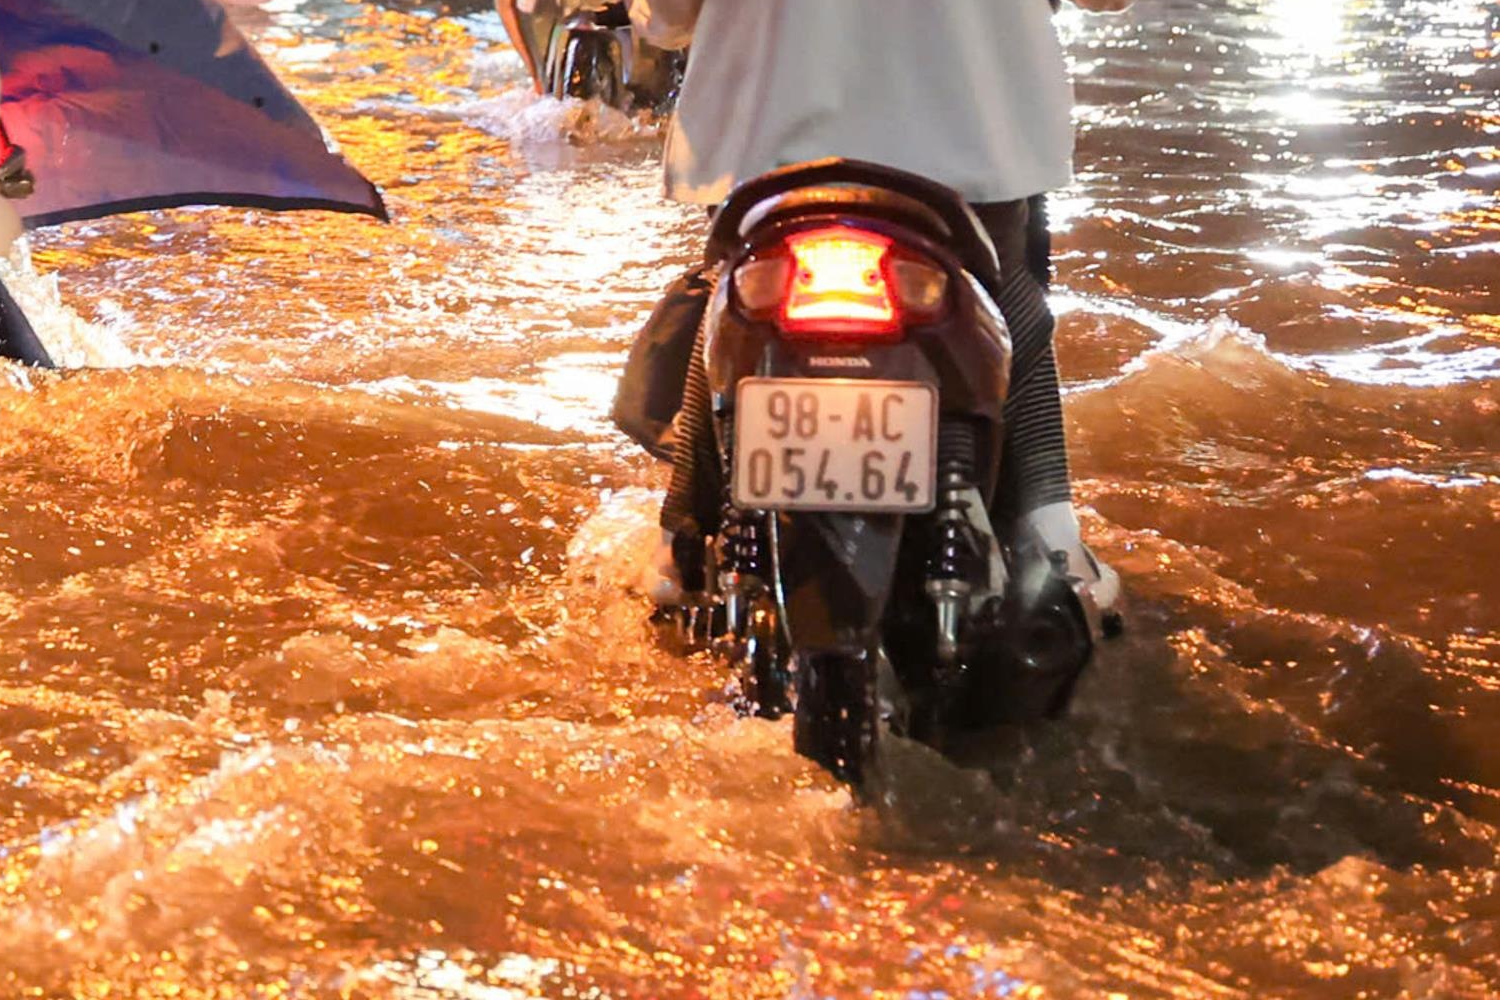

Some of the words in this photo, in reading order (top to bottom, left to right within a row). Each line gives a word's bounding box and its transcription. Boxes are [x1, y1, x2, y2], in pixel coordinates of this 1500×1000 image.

[810, 356, 871, 367] HONDA
[767, 390, 905, 442] 98-AC
[748, 448, 919, 502] 054.64
